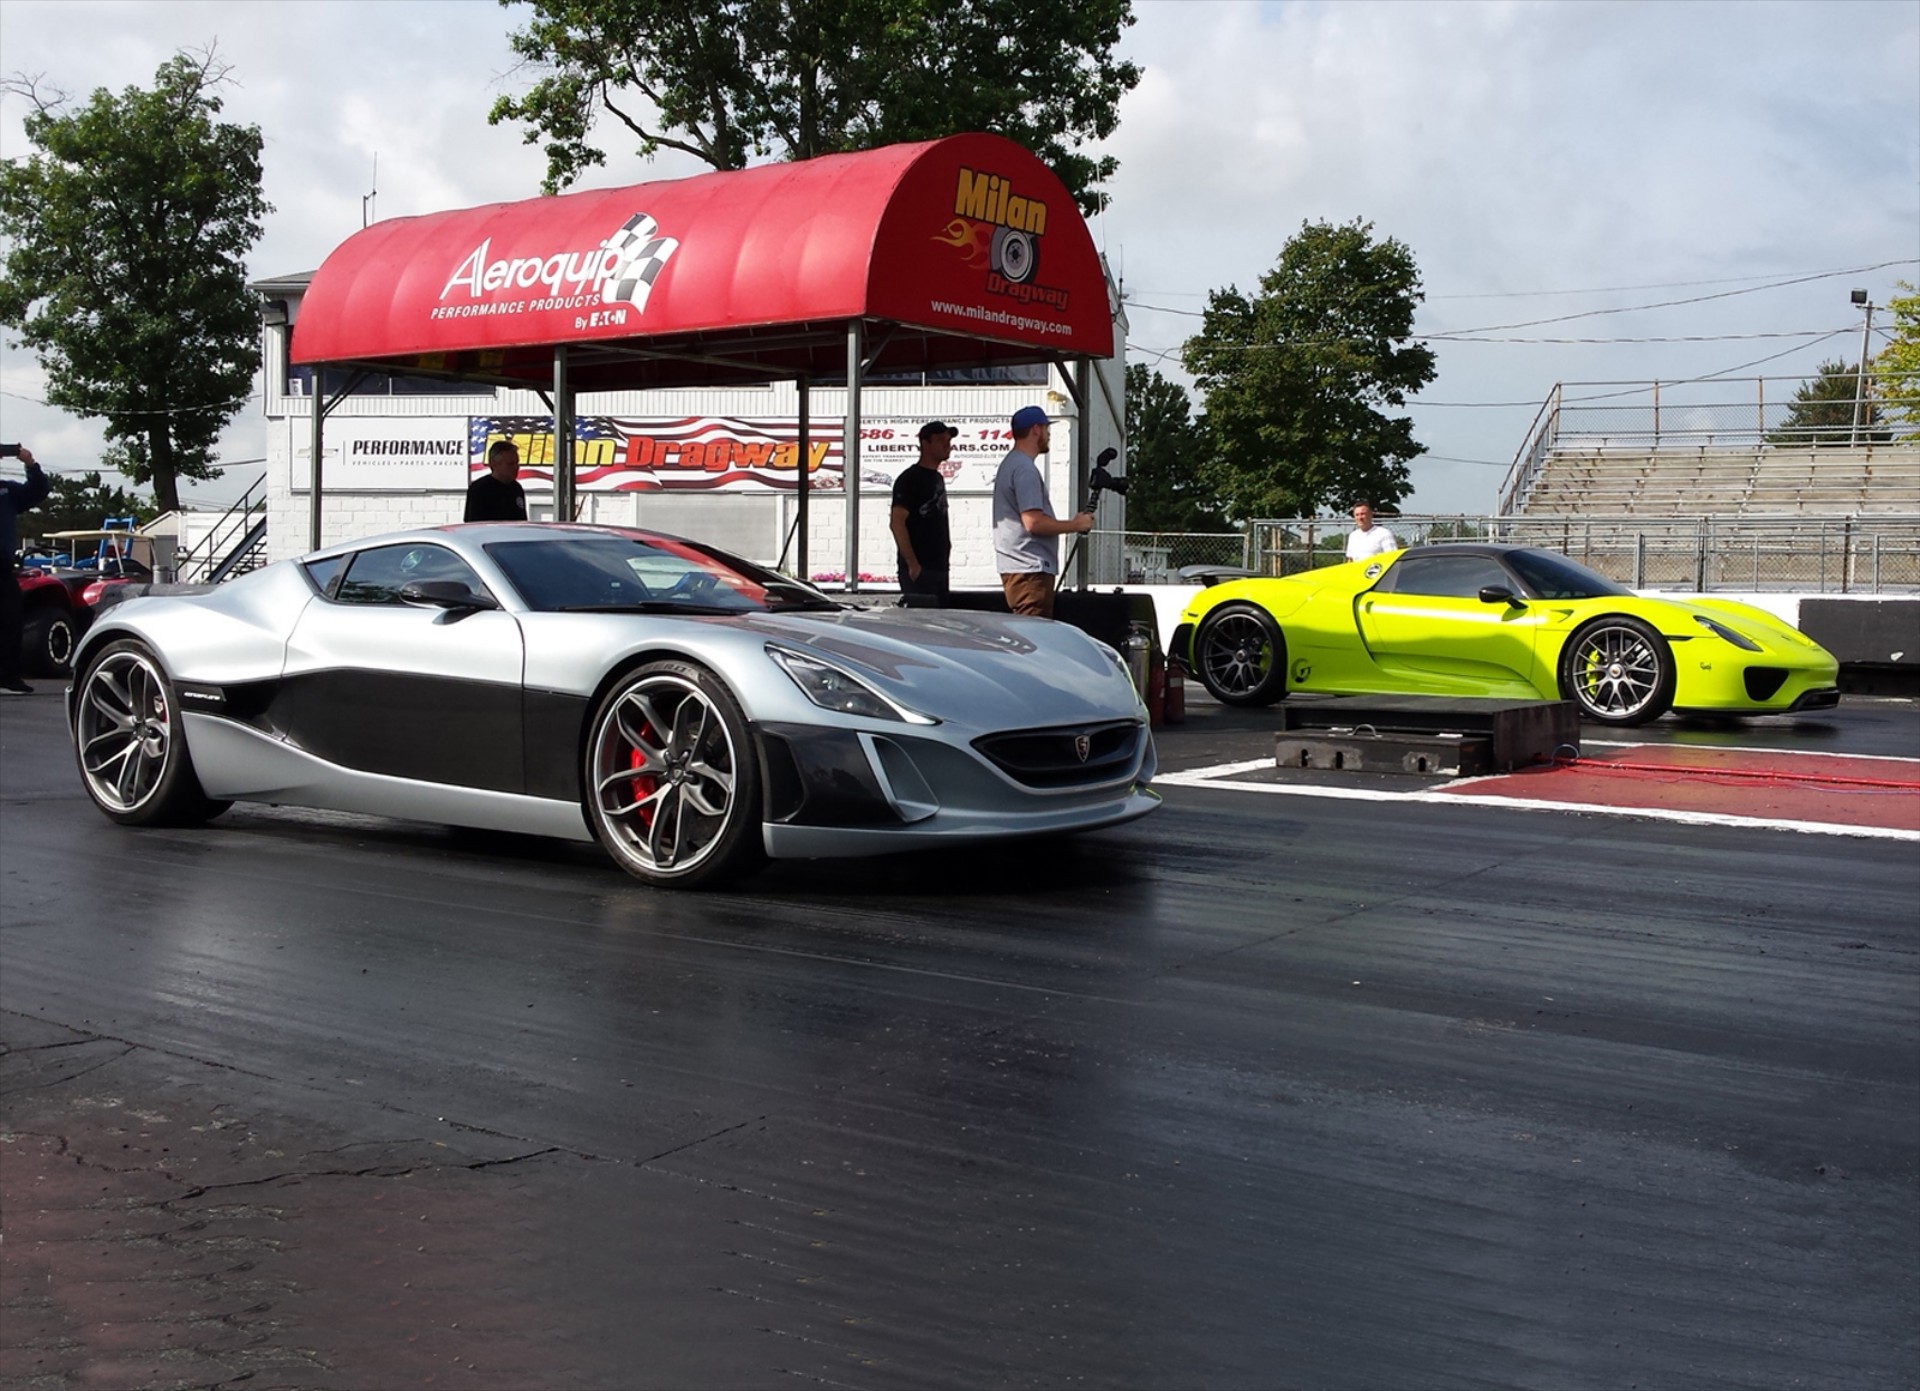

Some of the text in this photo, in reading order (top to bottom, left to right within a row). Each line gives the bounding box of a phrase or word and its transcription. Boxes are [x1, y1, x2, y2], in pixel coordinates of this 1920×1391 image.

[954, 167, 1048, 236] Milan
[438, 236, 627, 300] Aeroquip
[430, 293, 600, 320] PERFORMANCE PRODUCTS
[986, 271, 1070, 312] Dragway
[575, 316, 588, 331] By
[931, 300, 1073, 336] www.milandragway.com
[352, 440, 464, 455] PERFORMANCE
[625, 437, 830, 472] Dragway
